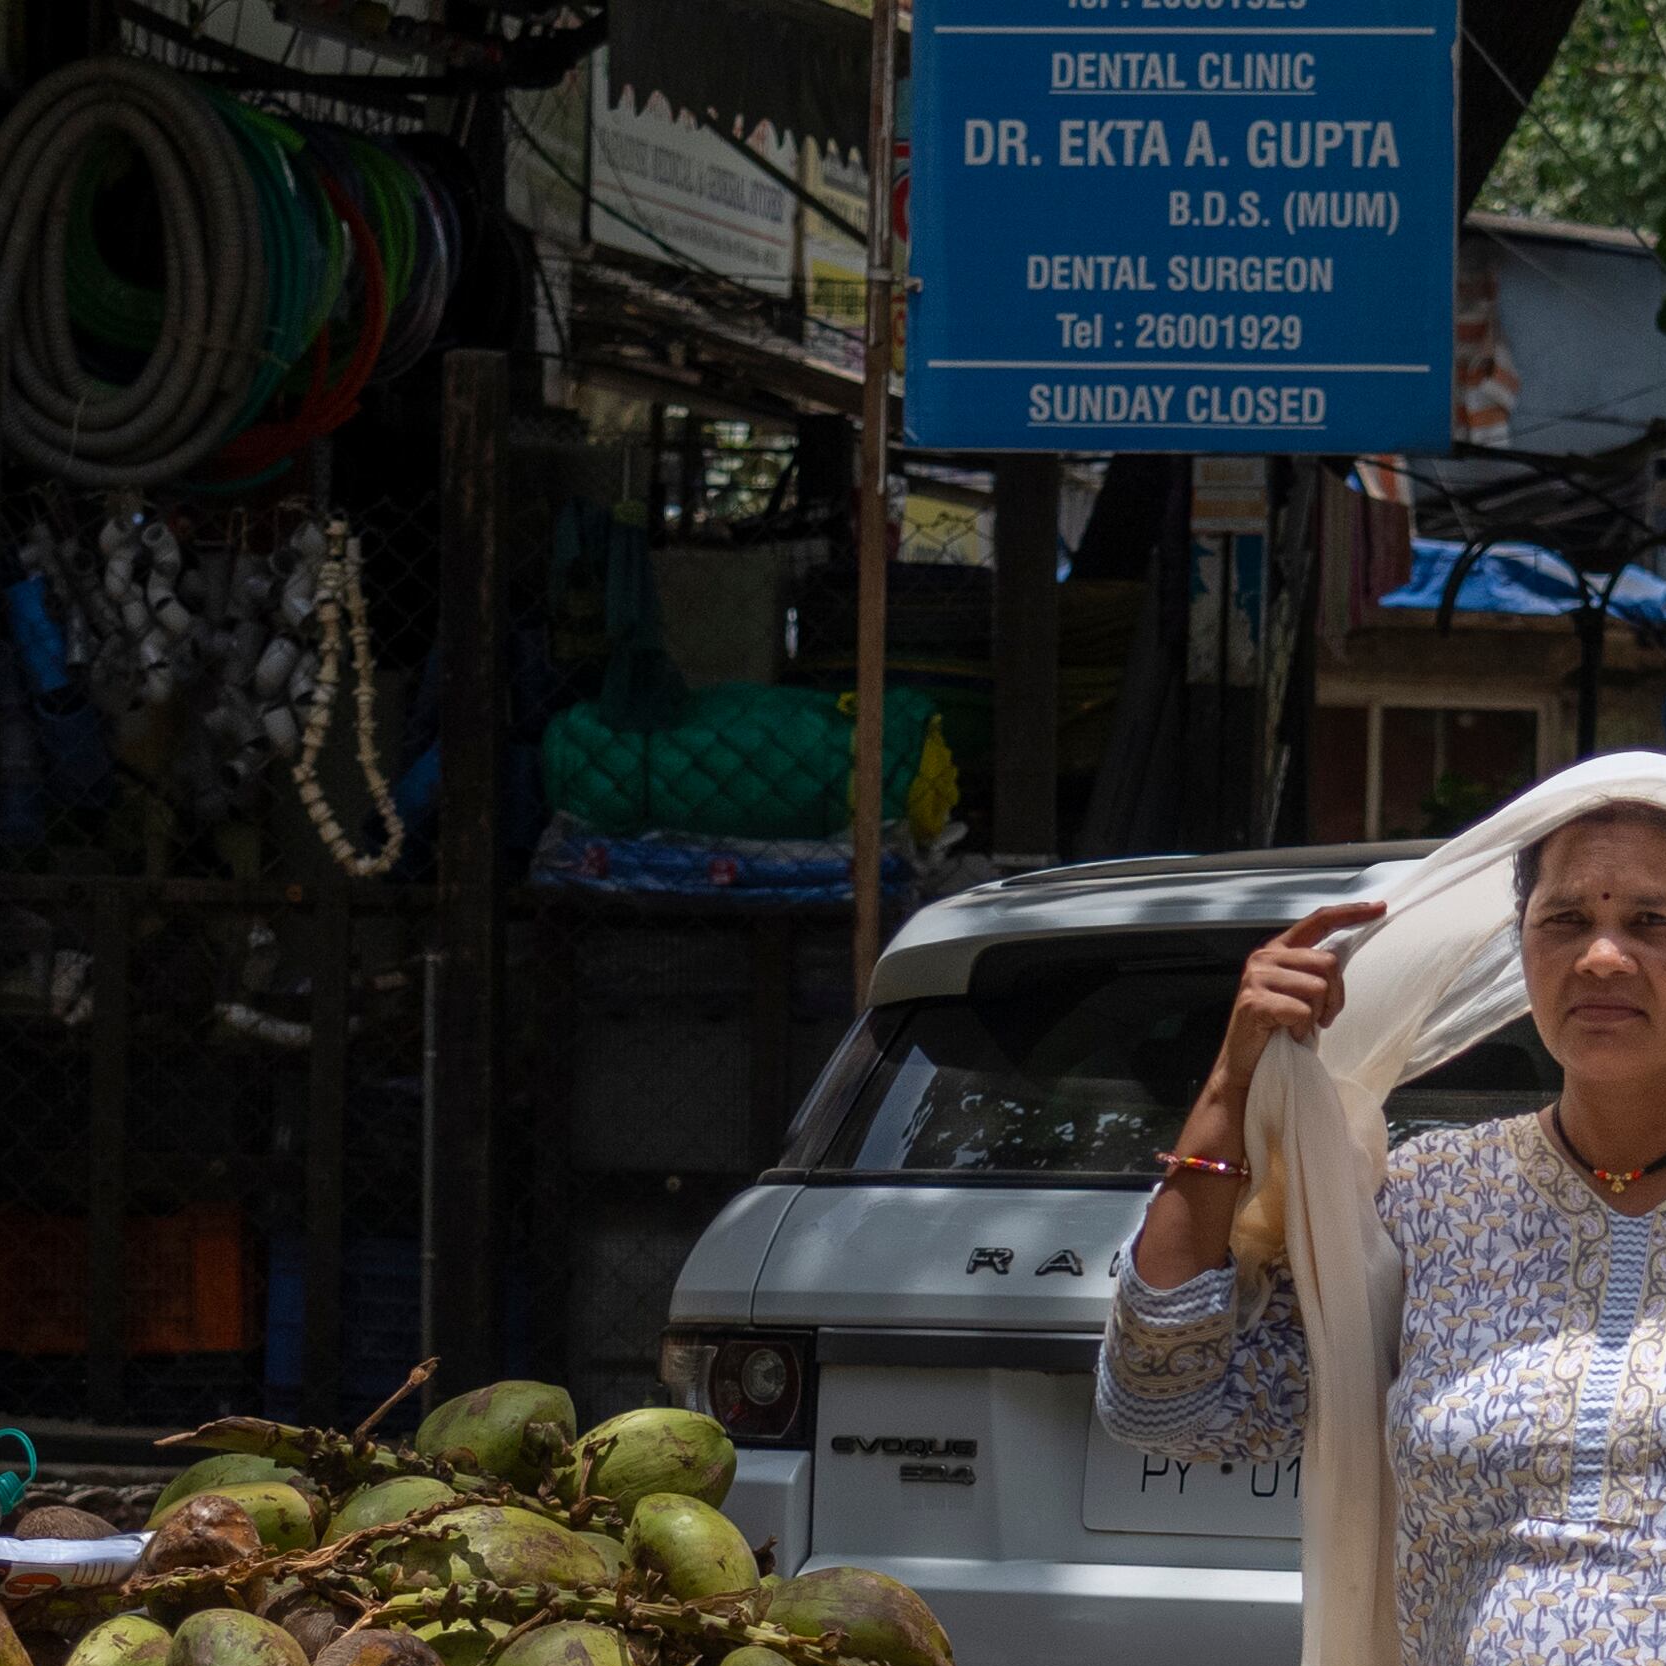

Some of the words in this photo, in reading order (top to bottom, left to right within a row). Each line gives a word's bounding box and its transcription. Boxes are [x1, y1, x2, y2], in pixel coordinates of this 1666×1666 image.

[1051, 52, 1188, 90] DENTAL
[1197, 52, 1317, 91] CLINIC
[963, 118, 1043, 168] DR.
[1058, 119, 1171, 168] EKTA
[1183, 119, 1231, 168] A.
[1246, 119, 1401, 169] GUPTA
[1168, 190, 1270, 228] B.D.S.
[1283, 191, 1400, 236] (MUM)
[1026, 255, 1157, 291] DENTAL
[1167, 256, 1333, 293] SURGEON
[1055, 313, 1104, 349] Tel
[1134, 314, 1303, 351] 26001929
[1028, 384, 1175, 422] SUNDAY
[1186, 386, 1327, 424] CLOSED
[966, 1247, 1120, 1278] RA
[832, 1437, 977, 1457] EVOQUE
